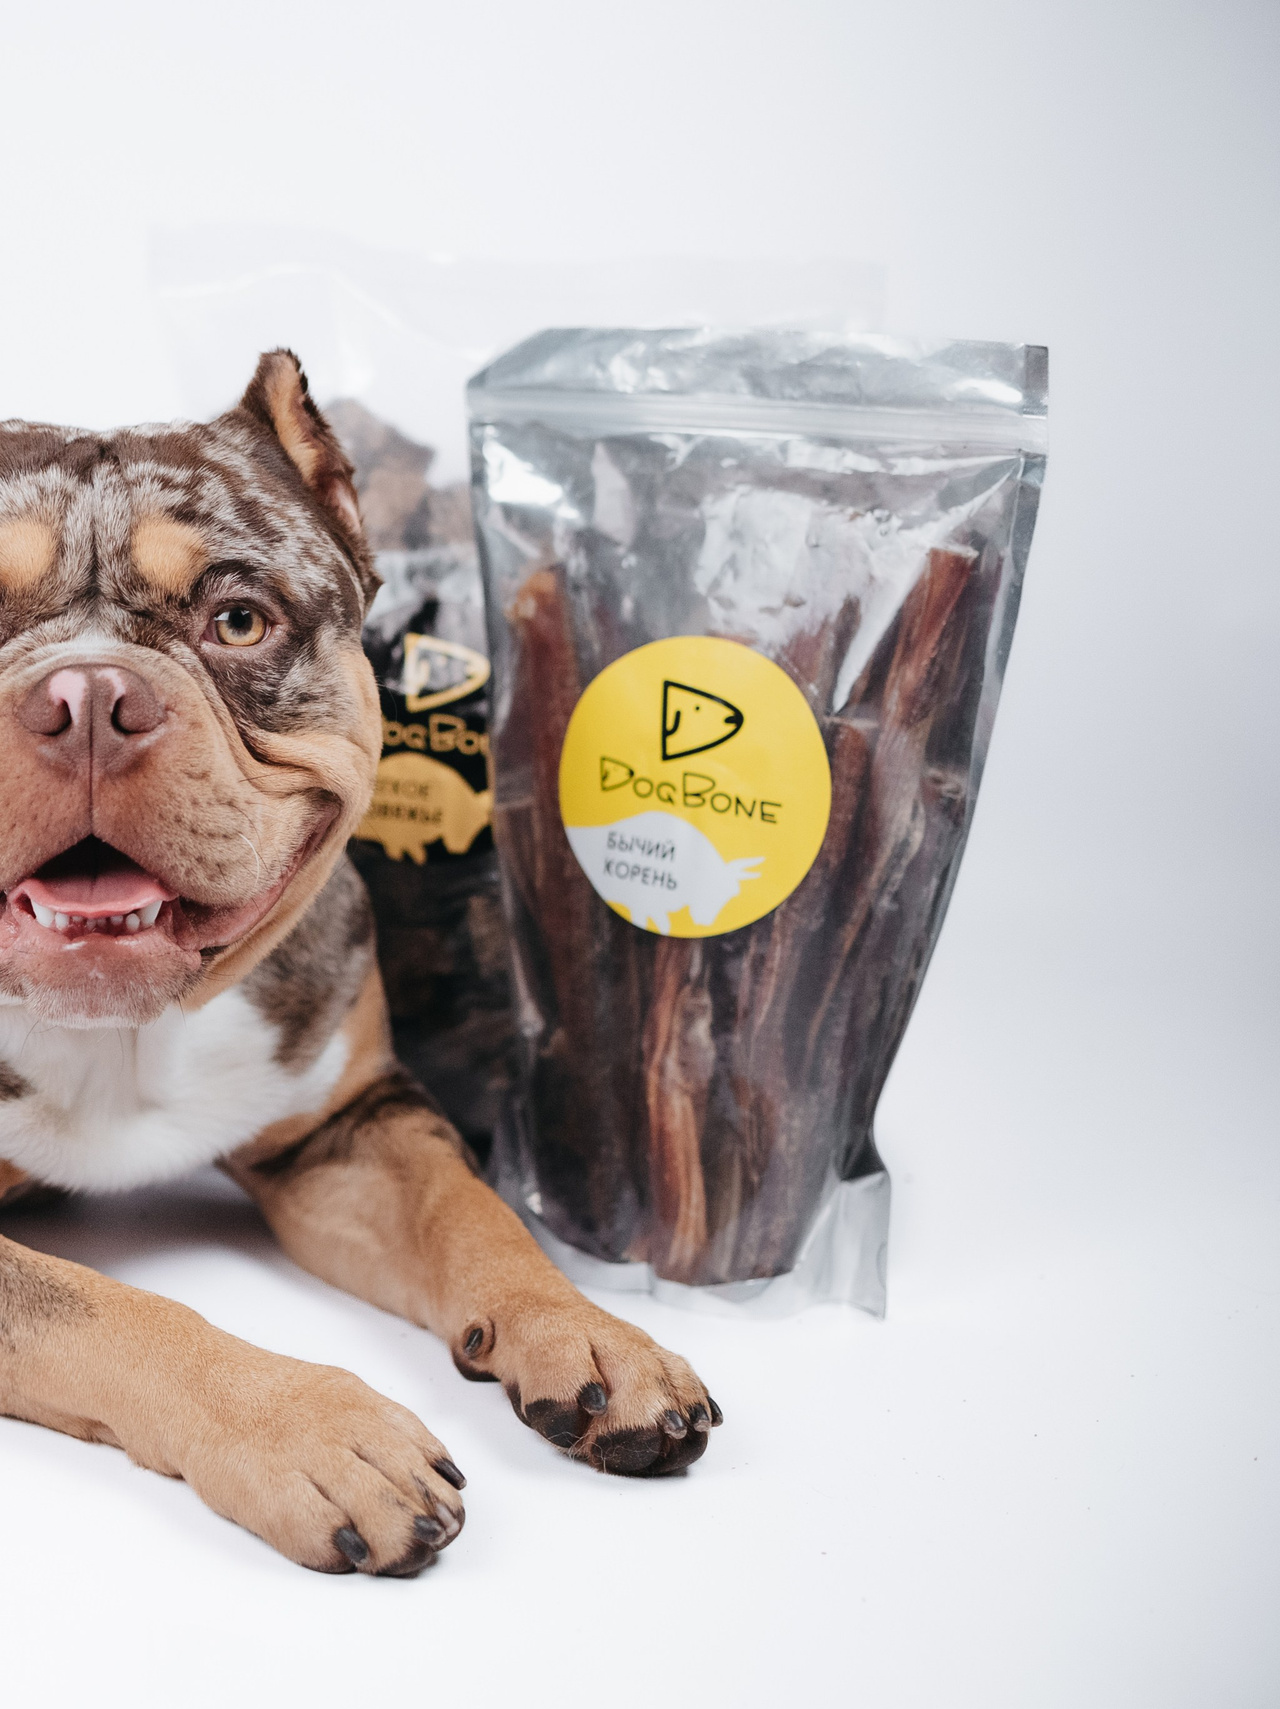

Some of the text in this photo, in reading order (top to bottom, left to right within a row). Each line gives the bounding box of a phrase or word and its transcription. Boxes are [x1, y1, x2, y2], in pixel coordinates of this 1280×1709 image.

[382, 713, 490, 756] OGBO
[606, 830, 676, 863] БЫЧИЙ
[603, 857, 678, 891] КОРЕНЬ
